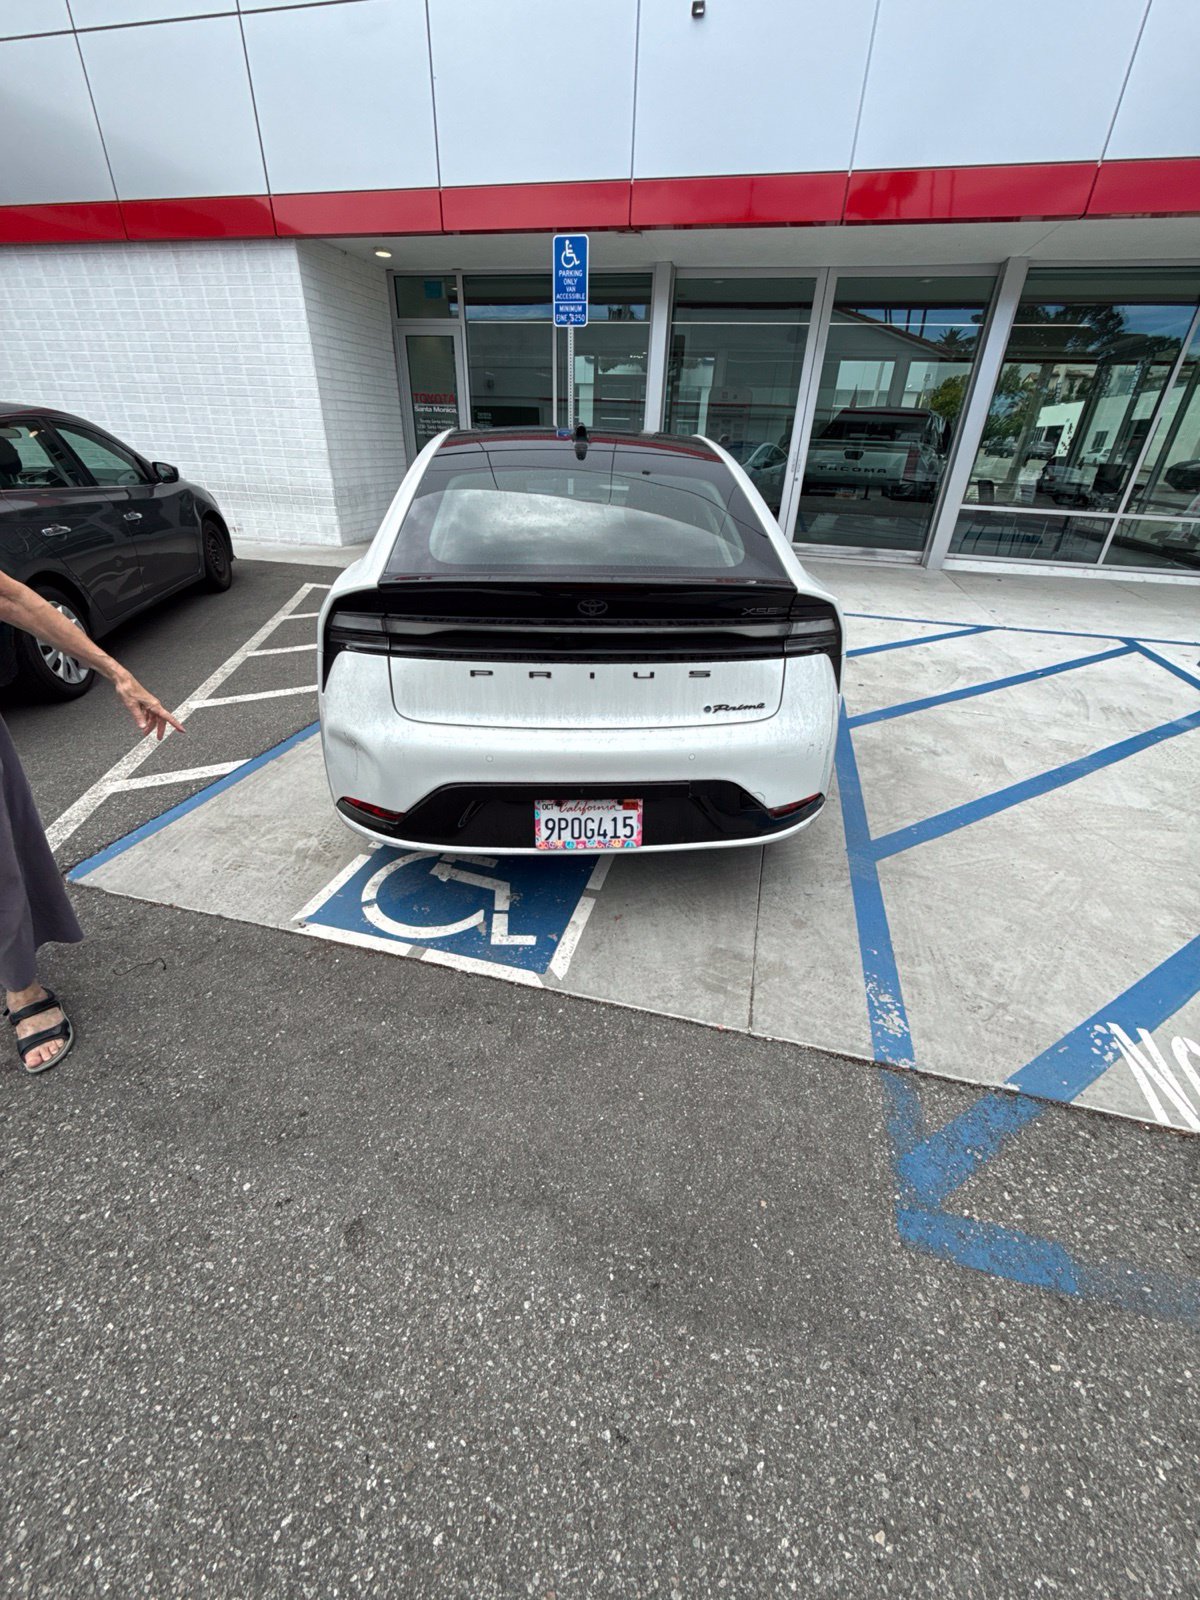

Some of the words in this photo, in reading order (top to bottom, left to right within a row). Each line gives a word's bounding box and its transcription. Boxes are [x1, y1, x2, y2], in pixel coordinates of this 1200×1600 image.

[558, 269, 583, 277] PARKING
[563, 278, 578, 286] ONLY
[414, 393, 455, 404] TOYOTA
[817, 465, 887, 474] TACOMA
[741, 607, 778, 616] XSE
[470, 669, 711, 680] PRIUS
[712, 702, 766, 714] Prime
[541, 803, 555, 811] OCT
[559, 801, 622, 816] California
